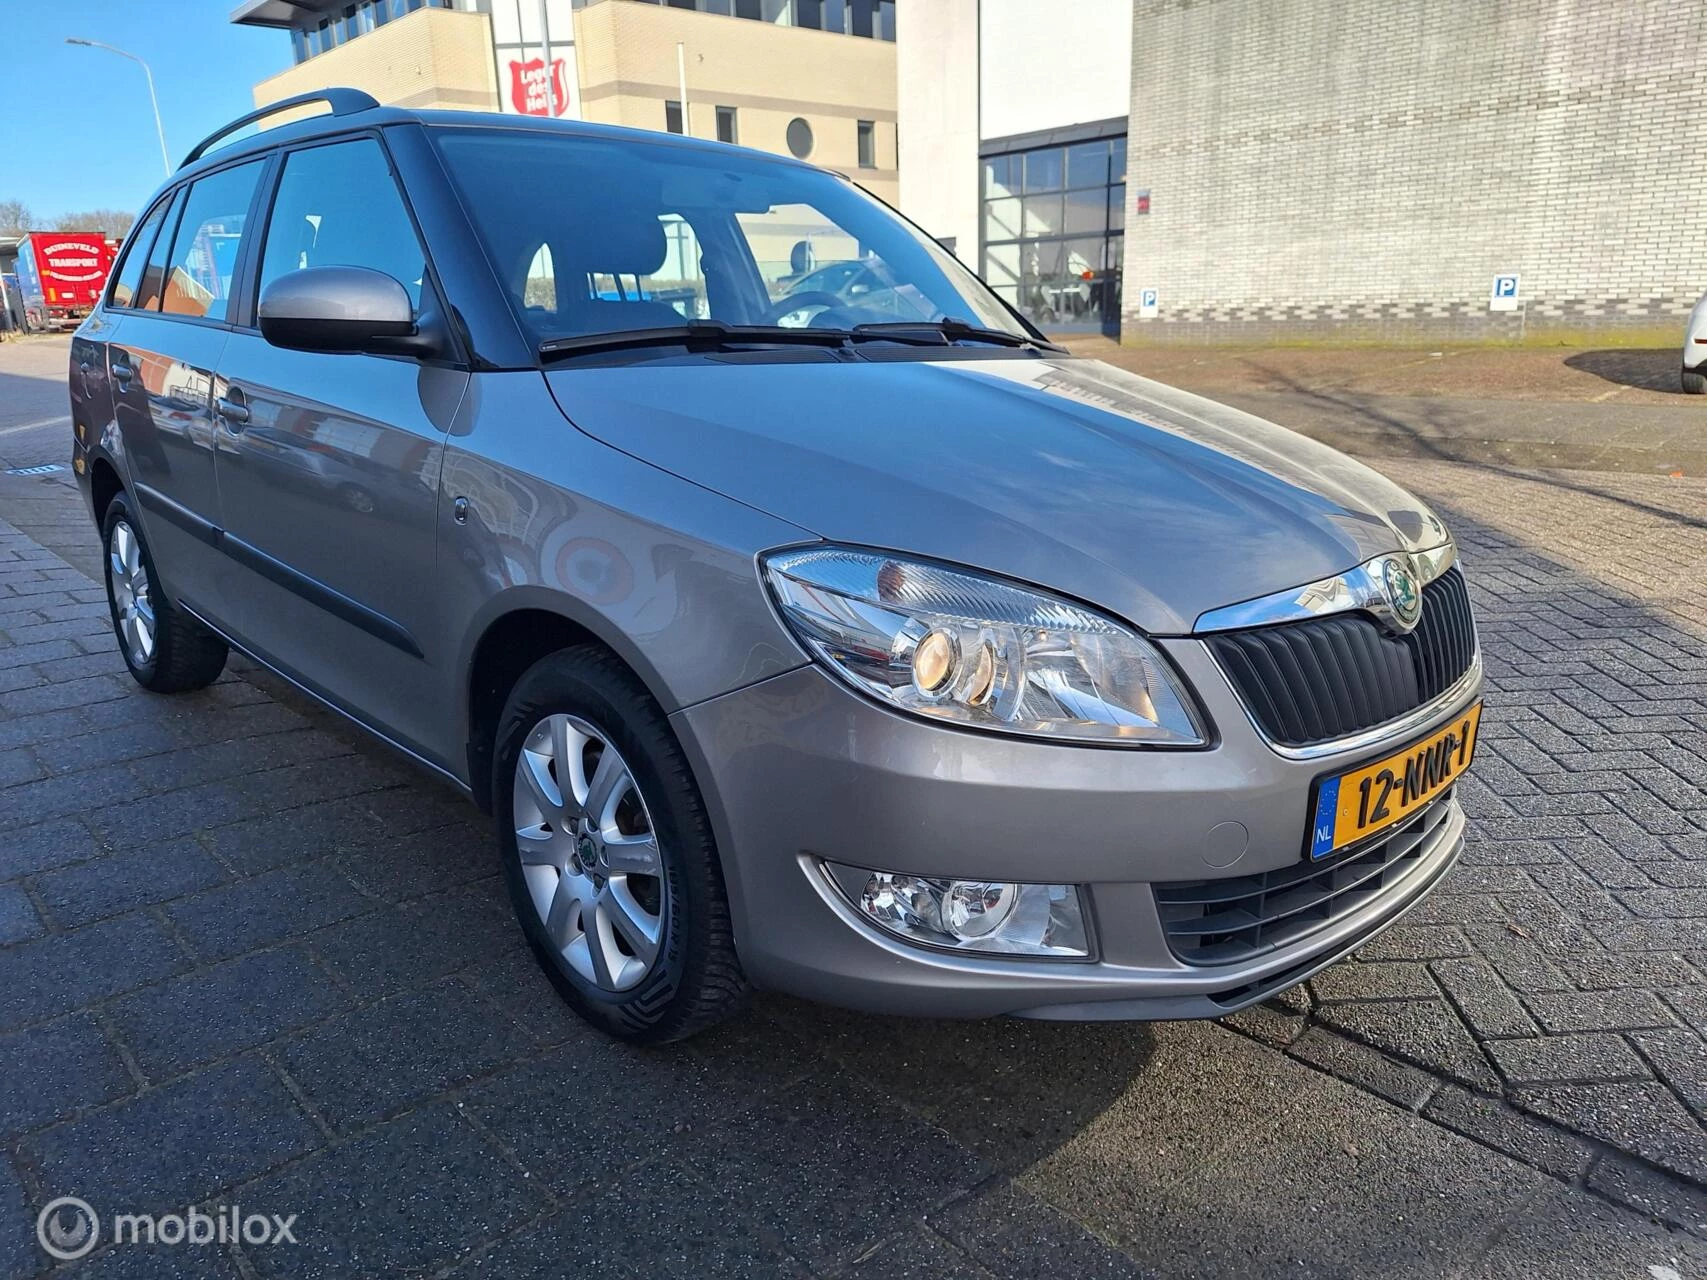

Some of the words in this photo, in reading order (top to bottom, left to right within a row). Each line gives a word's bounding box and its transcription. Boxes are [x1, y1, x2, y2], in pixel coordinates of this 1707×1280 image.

[526, 94, 558, 111] Heis
[48, 258, 98, 267] TRANSPORT
[1499, 279, 1514, 296] P
[1145, 291, 1155, 306] P
[1357, 720, 1470, 829] 12-NNR-1
[1316, 828, 1331, 843] NL
